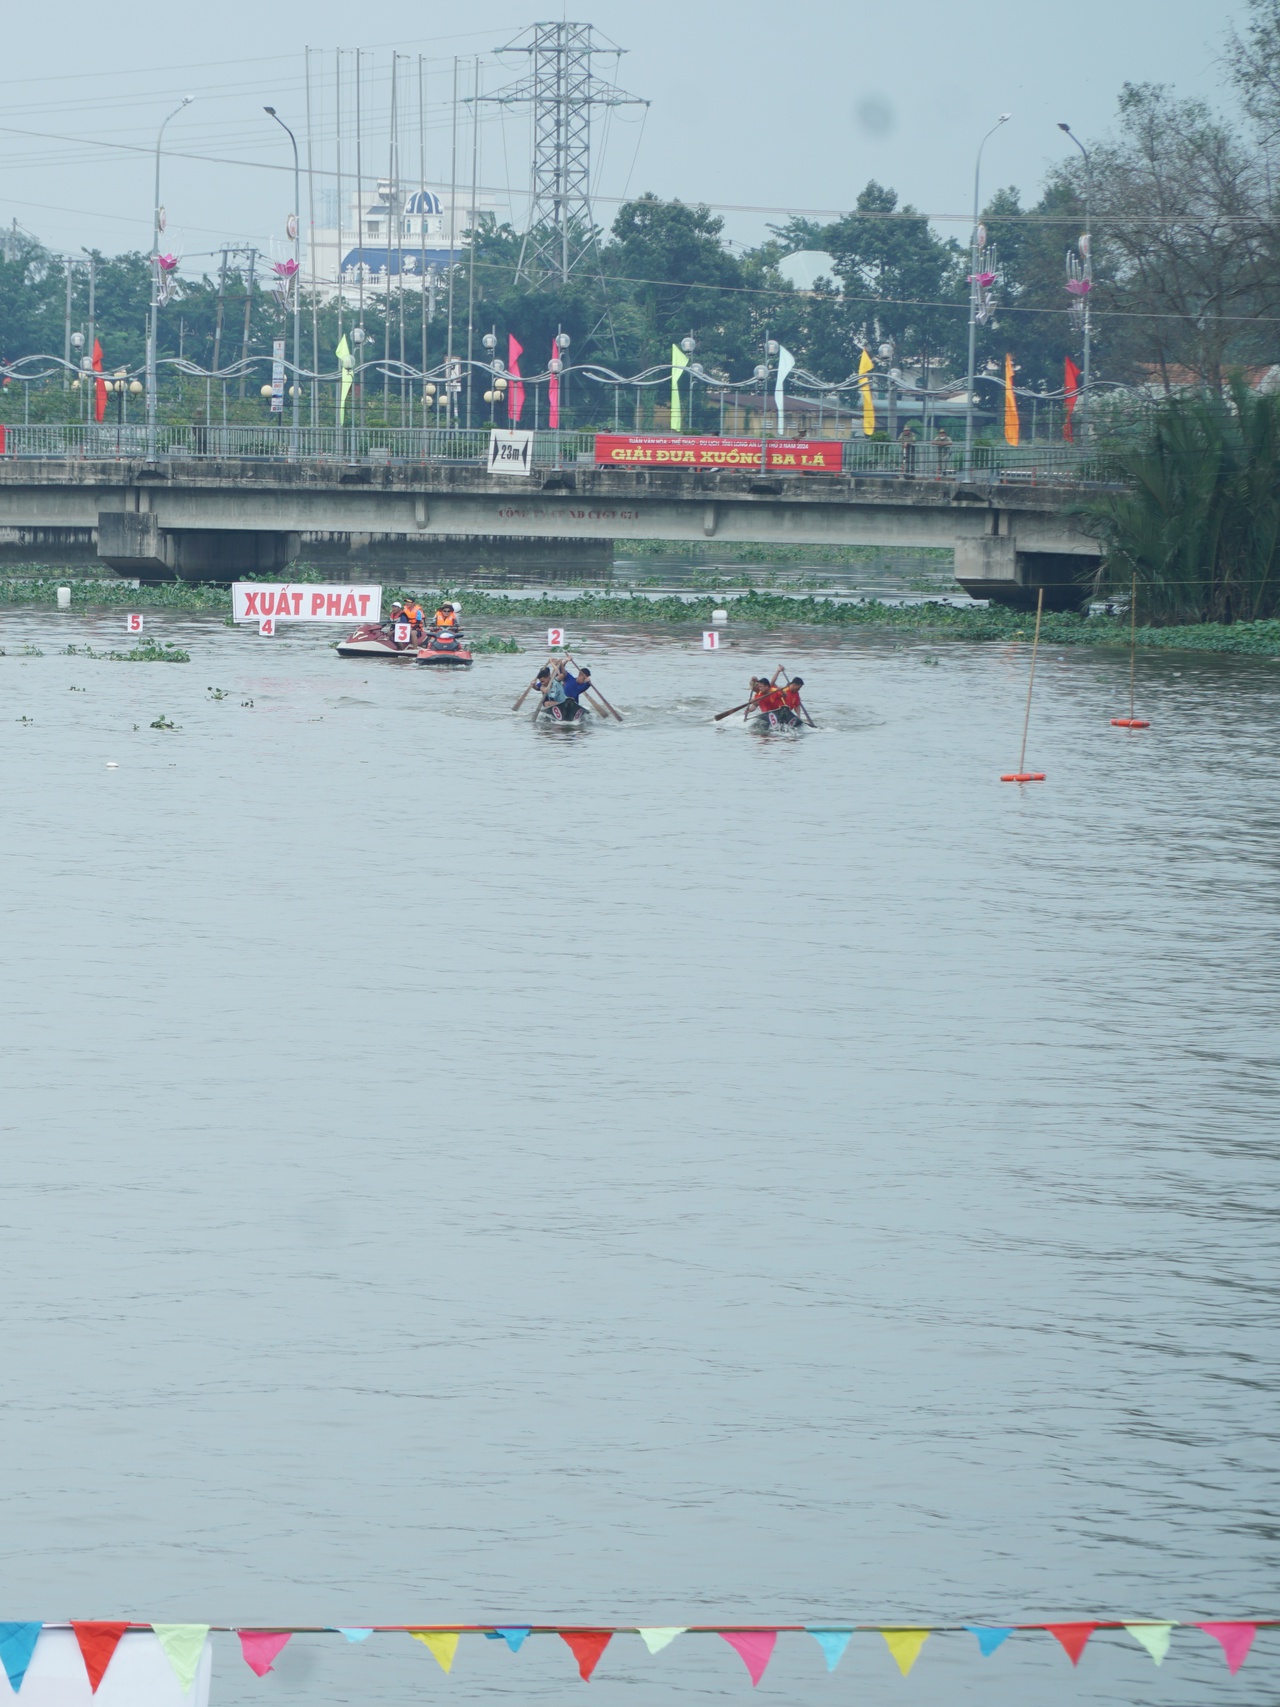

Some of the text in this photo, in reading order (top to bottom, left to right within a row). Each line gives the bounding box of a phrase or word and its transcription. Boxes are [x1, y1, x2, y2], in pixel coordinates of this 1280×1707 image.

[501, 444, 520, 460] 23m
[611, 446, 652, 461] GIẢI
[656, 450, 696, 462] ĐUA
[771, 453, 796, 465] BA
[801, 452, 825, 466] LÁ
[244, 584, 371, 617] XUẤT PHÁT
[131, 615, 141, 631] 5
[261, 619, 273, 634] 4
[397, 625, 408, 641] 3
[551, 630, 561, 645] 2
[708, 632, 715, 647] 1
